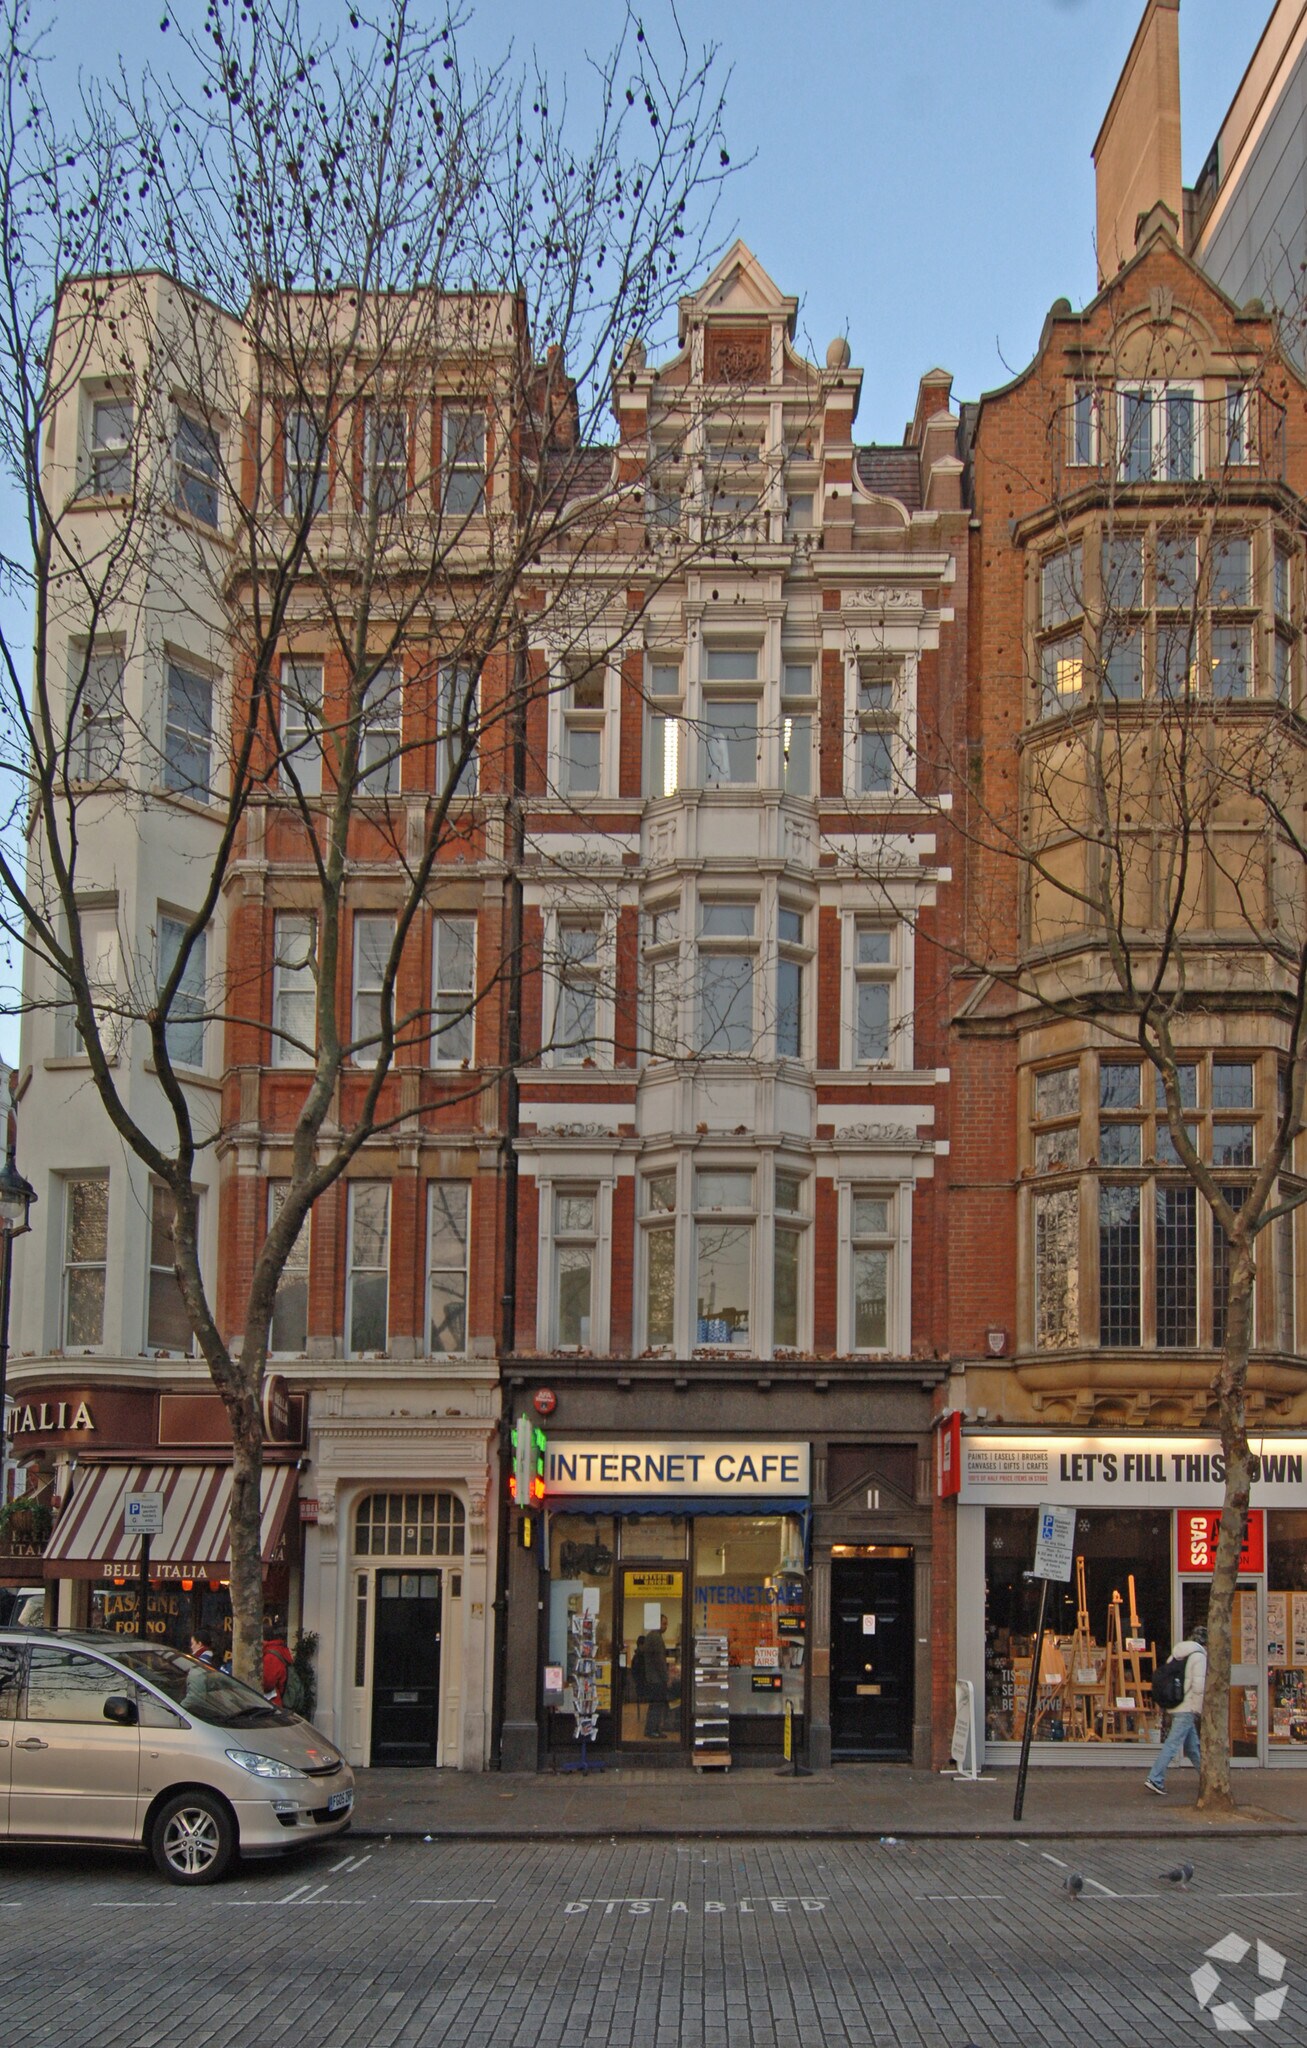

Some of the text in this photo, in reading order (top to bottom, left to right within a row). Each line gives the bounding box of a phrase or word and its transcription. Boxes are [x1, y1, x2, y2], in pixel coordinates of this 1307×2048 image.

[8, 1401, 95, 1435] ITALIA
[968, 1453, 1048, 1461] PAINTS EASELS BRUSHES
[550, 1454, 799, 1482] INTERNET CAFE
[968, 1462, 1048, 1470] CANVASES GIFTS CRAFTS
[1060, 1453, 1117, 1483] LET'S
[1124, 1453, 1167, 1483] FILL
[1171, 1454, 1226, 1483] THIS
[406, 1528, 414, 1538] 9
[1210, 1518, 1253, 1541] AT
[1190, 1517, 1208, 1565] CASS
[103, 1564, 208, 1578] BELL ITALIA
[694, 1585, 763, 1604] INTERNET
[1002, 1698, 1014, 1711] BE
[563, 1900, 826, 1915] DISABLED
